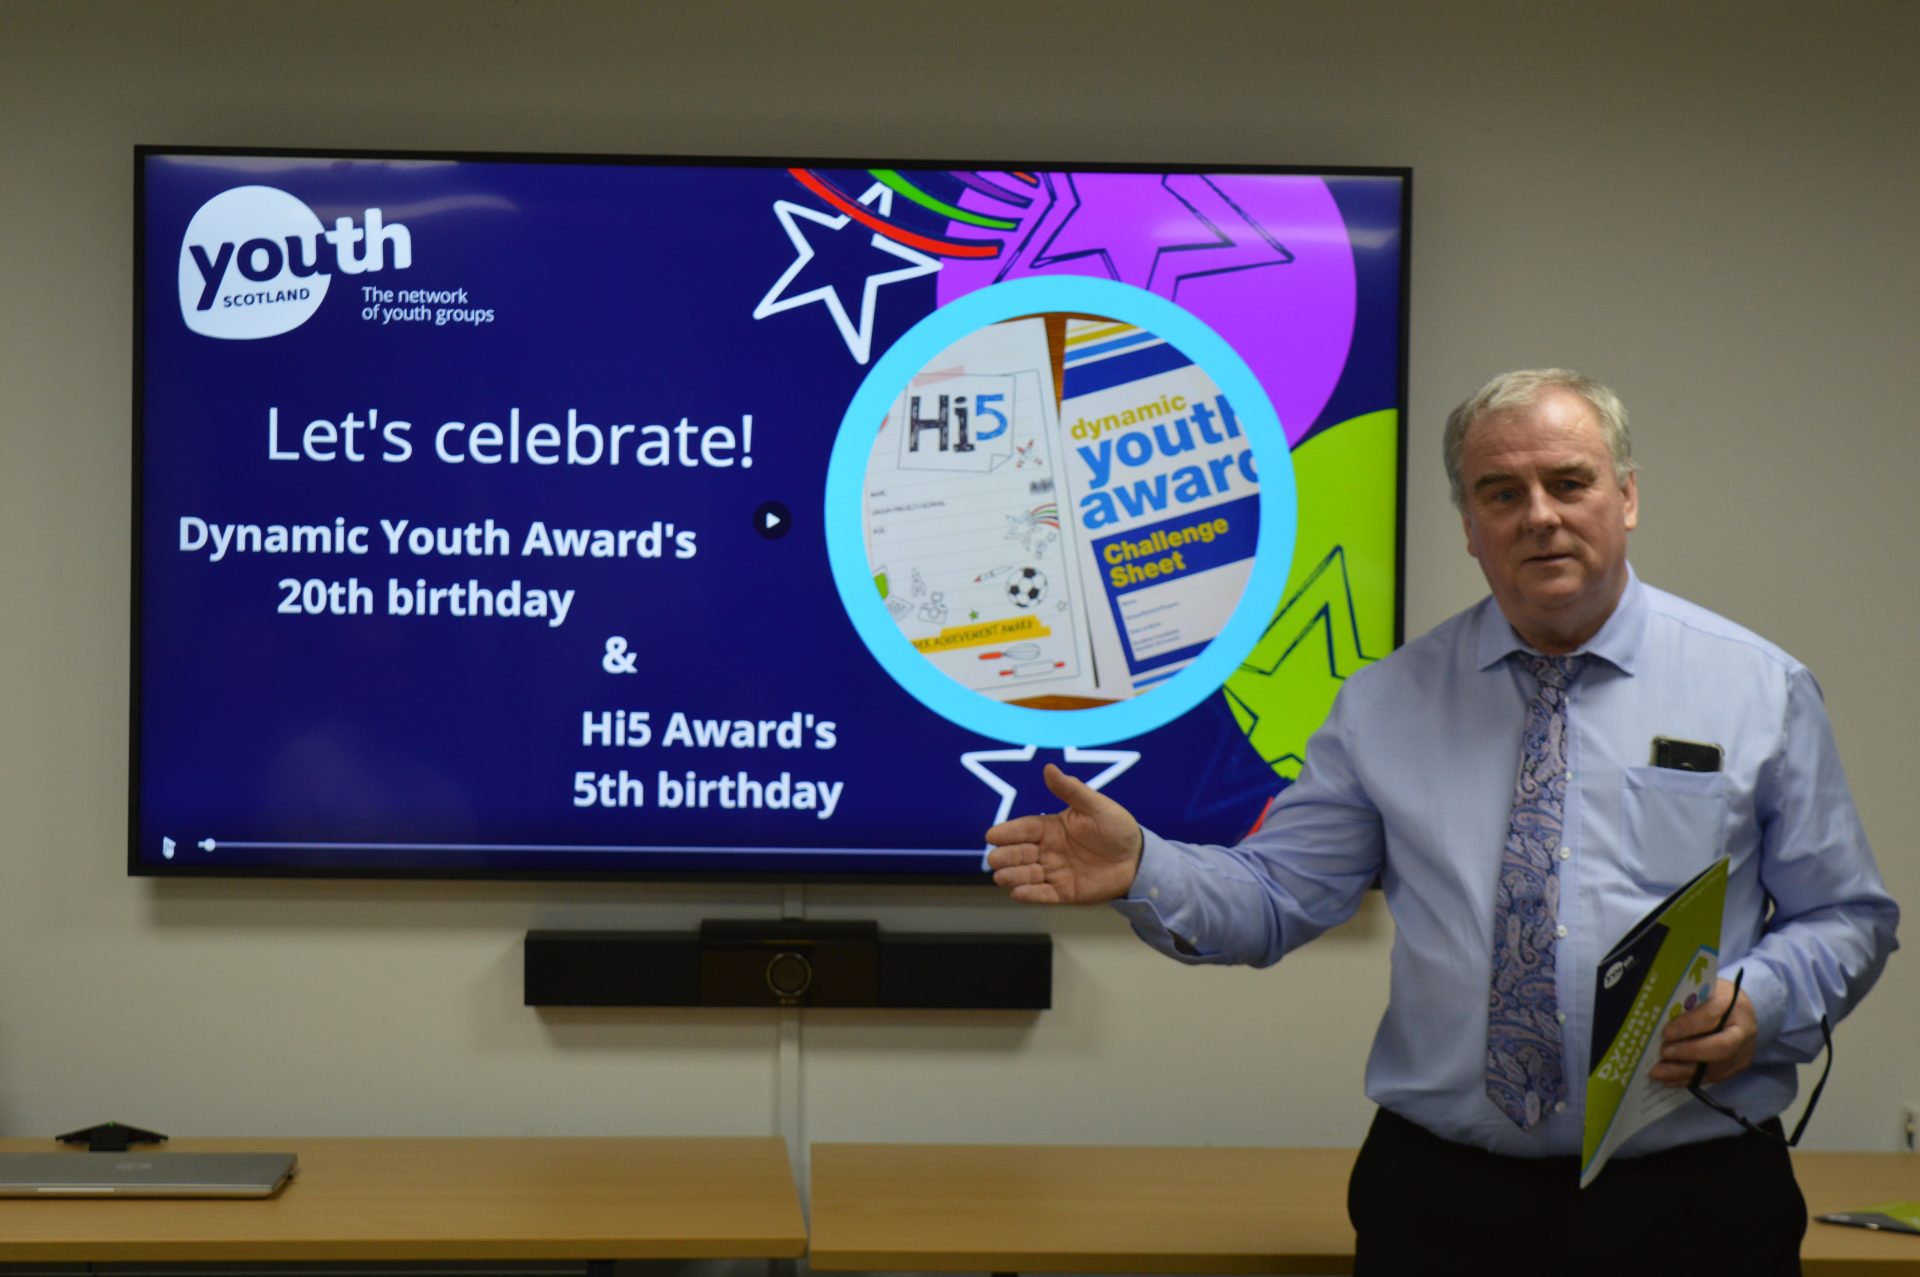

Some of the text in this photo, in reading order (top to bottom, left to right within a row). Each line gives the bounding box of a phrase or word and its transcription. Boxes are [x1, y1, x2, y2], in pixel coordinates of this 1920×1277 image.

[189, 207, 412, 312] youth
[223, 288, 310, 308] SCOTLAND
[361, 286, 468, 305] The network
[361, 304, 495, 326] of youth groups
[268, 406, 754, 469] Let's celebrate!
[908, 393, 1009, 453] Hi5
[1070, 395, 1186, 440] dynamic
[179, 516, 697, 562] Dynamic Youth Award's
[1103, 518, 1230, 565] Challenge
[1109, 551, 1186, 588] Sheet
[277, 577, 576, 628] 20th birthday
[602, 635, 638, 674] &
[582, 709, 837, 750] Hi5 Award's
[573, 769, 844, 820] 5th birthday
